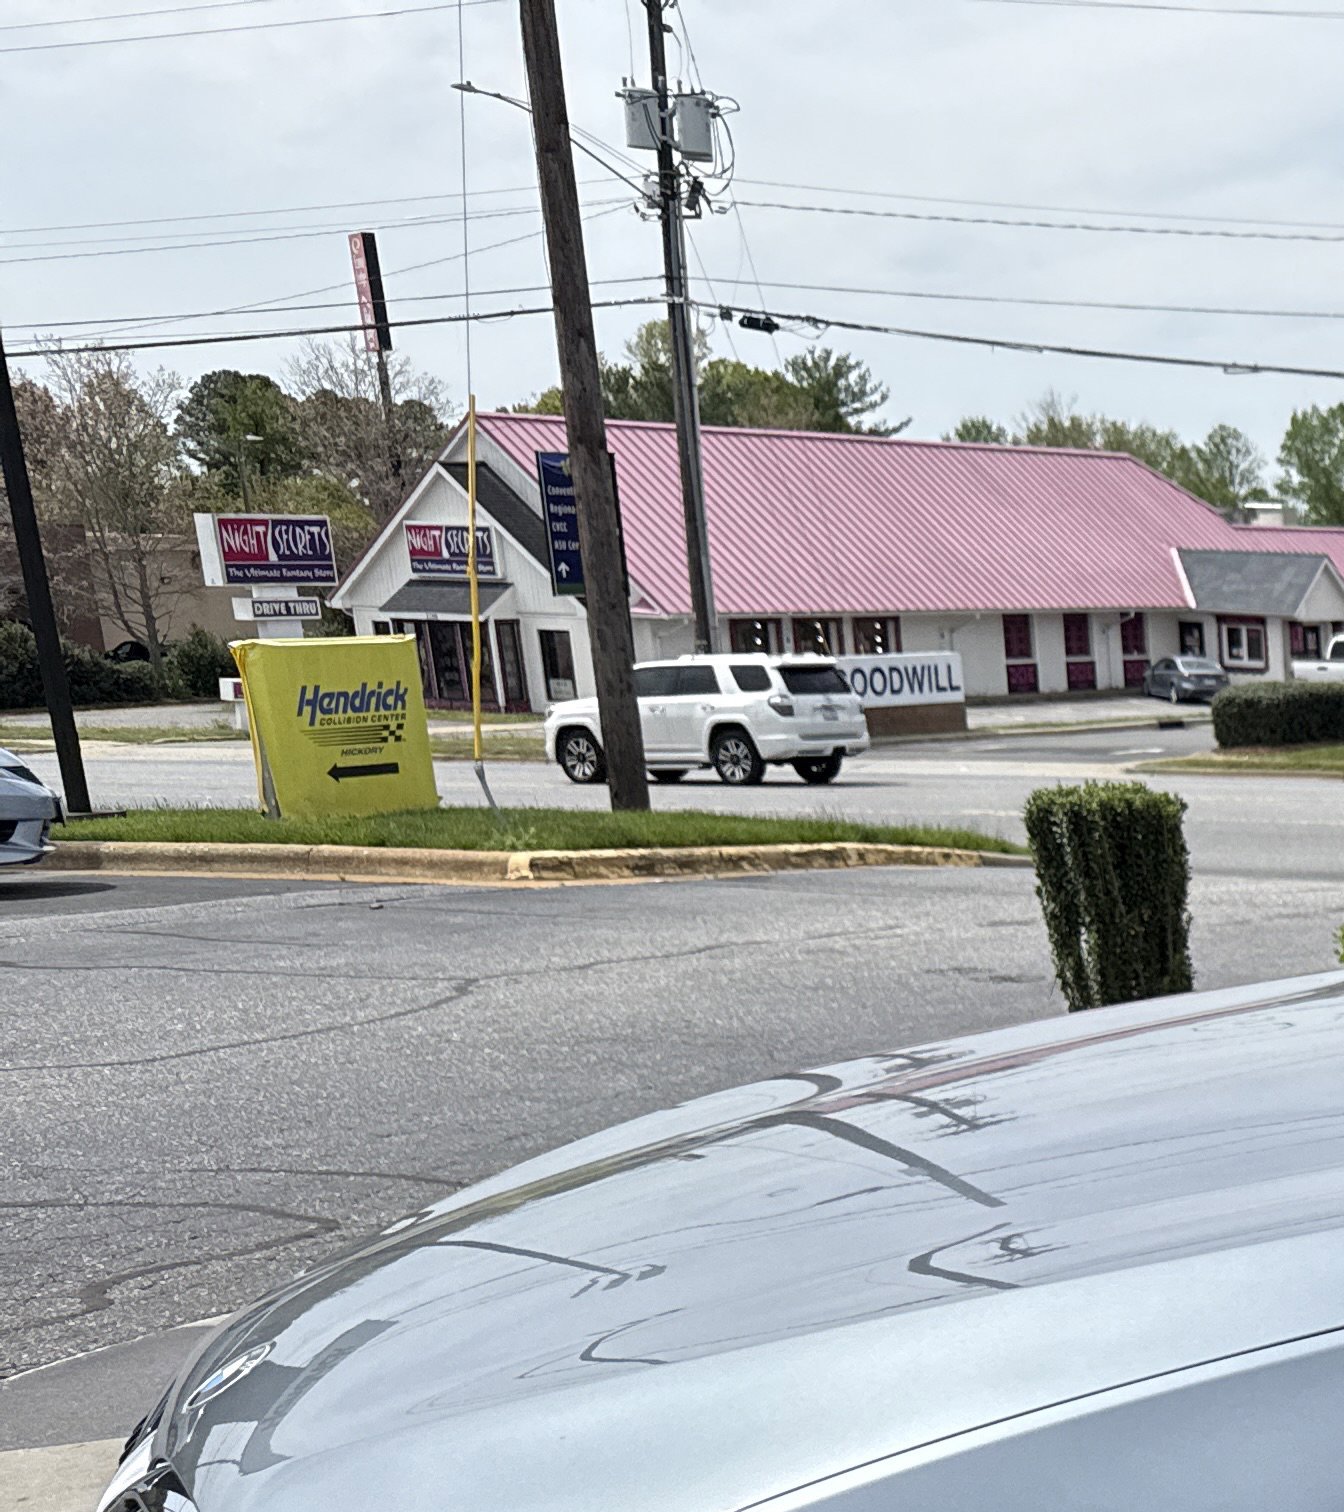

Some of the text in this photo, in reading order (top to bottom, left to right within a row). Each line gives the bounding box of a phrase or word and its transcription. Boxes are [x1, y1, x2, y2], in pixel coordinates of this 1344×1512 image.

[274, 524, 331, 556] SECRETS
[446, 529, 489, 555] SECRTS
[227, 566, 334, 580] The Ultimate Fantasy Store
[254, 601, 318, 615] DRIVE THRU
[297, 681, 408, 727] Hendrick
[320, 713, 407, 726] COLLISION CENTER
[341, 746, 385, 757] HICKORY
